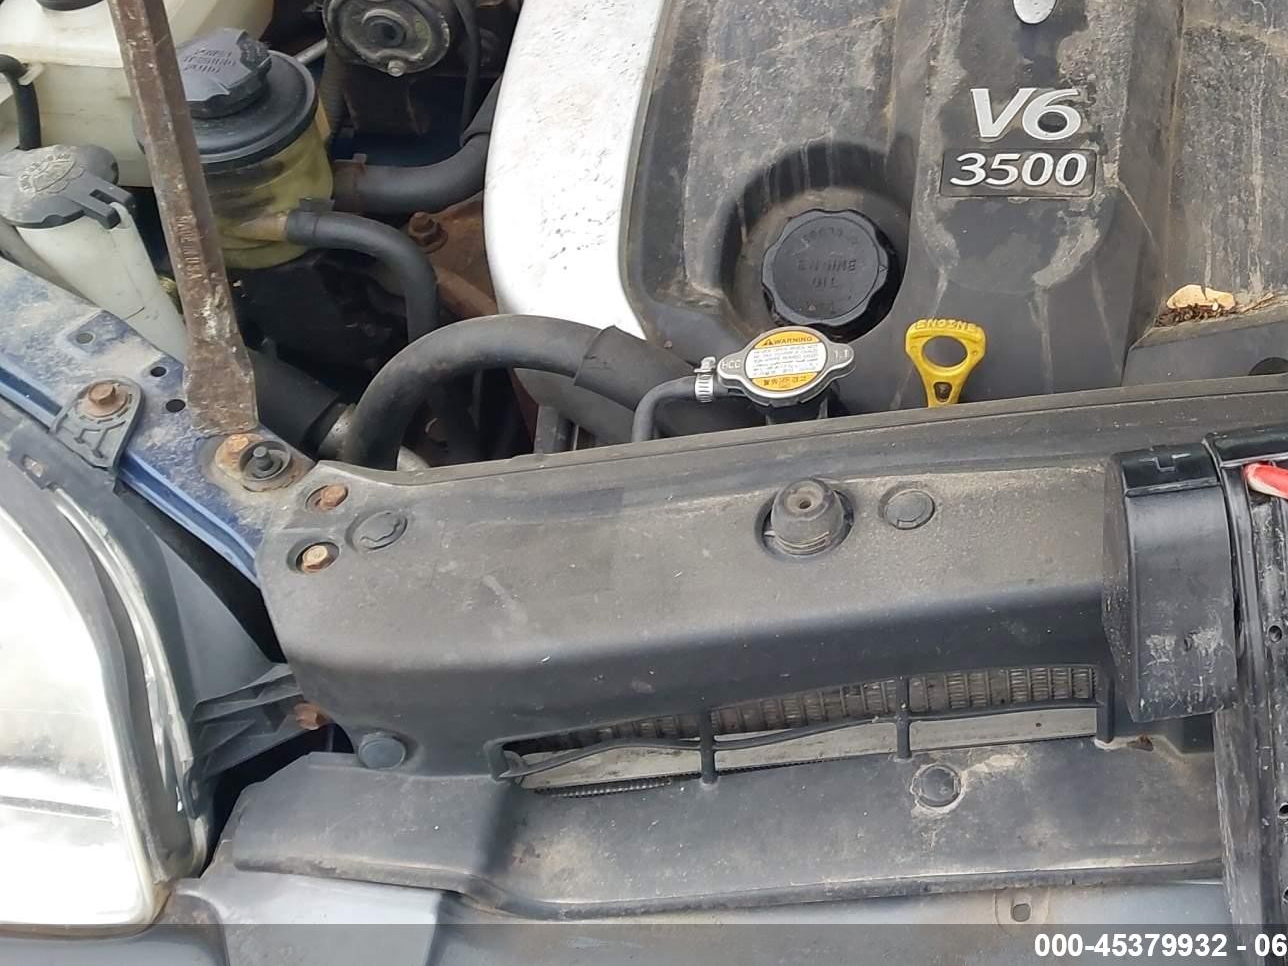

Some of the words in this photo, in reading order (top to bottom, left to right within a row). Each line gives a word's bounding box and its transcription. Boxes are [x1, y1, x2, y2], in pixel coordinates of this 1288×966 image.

[969, 86, 1085, 142] V6
[948, 150, 1090, 189] 3500
[915, 318, 978, 332] ENGINE
[773, 335, 814, 345] WARNING
